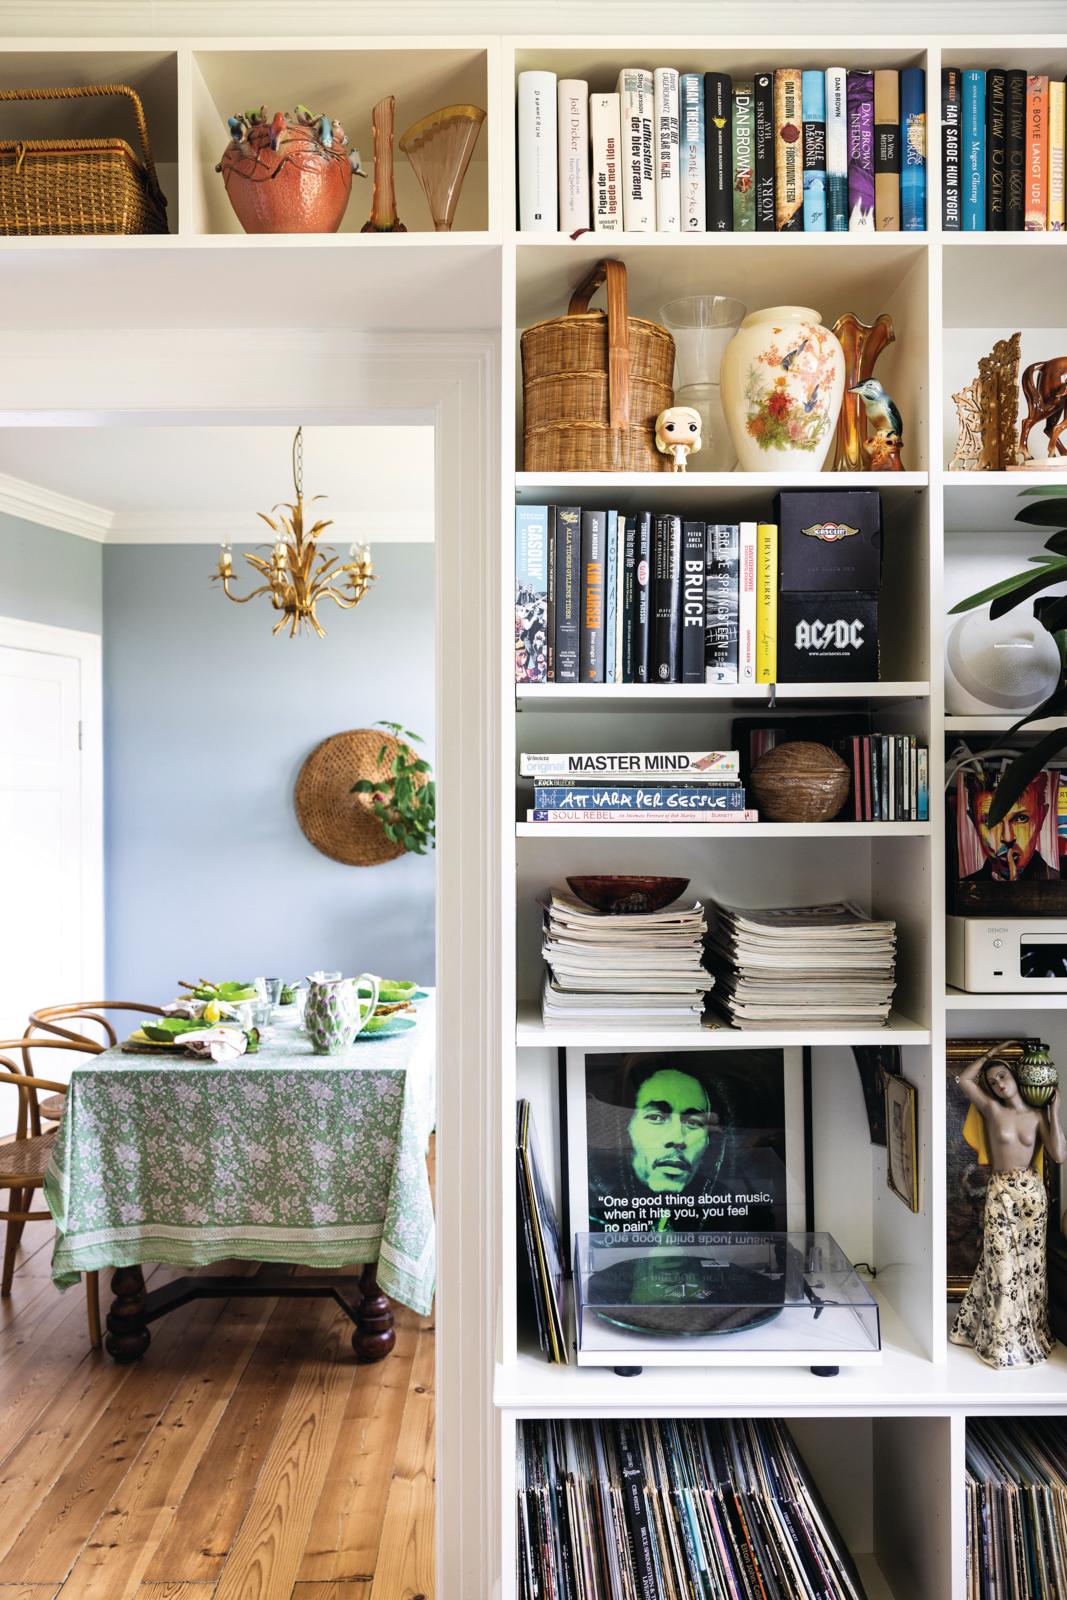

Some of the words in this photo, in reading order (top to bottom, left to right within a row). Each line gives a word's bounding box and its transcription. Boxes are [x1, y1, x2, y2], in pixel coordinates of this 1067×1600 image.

[686, 77, 699, 103] JOHAN
[785, 82, 795, 95] DAN
[735, 96, 750, 125] DAN
[785, 96, 796, 119] BROWN
[861, 103, 871, 127] DAN
[946, 105, 957, 125] HAN
[631, 117, 641, 132] der
[660, 117, 670, 131] IKKE
[670, 117, 678, 129] DET
[686, 106, 699, 142] THEORIN
[757, 101, 765, 159] SKYGGERNES
[764, 121, 772, 139] HAV
[1032, 109, 1041, 139] BOYLE
[570, 119, 580, 152] Dicker
[632, 136, 642, 157] blev
[805, 124, 815, 167] DÆMONER
[815, 130, 825, 160] ENGLE
[851, 113, 861, 159] INFERNO
[946, 128, 958, 162] SAGDE
[606, 137, 615, 161] ilden
[643, 117, 653, 181] Luftkastellet
[661, 151, 670, 160] OS
[688, 145, 698, 177] Sankt
[736, 131, 751, 178] BROWN
[861, 130, 871, 170] BROWN
[970, 141, 980, 170] Mogens
[1032, 143, 1041, 178] LANGT
[598, 172, 606, 187] der
[606, 163, 615, 182] med
[631, 160, 643, 201] sprængt
[947, 166, 957, 186] HUN
[607, 185, 617, 214] legede
[687, 182, 699, 213] Psyko
[762, 177, 774, 222] MØRK
[786, 187, 796, 203] TEGN
[970, 172, 981, 203] Glistrup
[1032, 183, 1041, 204] UDE
[598, 190, 607, 215] Pigen
[627, 529, 636, 541] This
[626, 548, 634, 557] my
[717, 530, 730, 569] BRUCE
[586, 563, 602, 585] KIM
[626, 558, 635, 568] life
[684, 560, 703, 627] BRUCE
[586, 587, 601, 629] LARSEN
[717, 573, 730, 649] SPRINGSTEEN
[527, 761, 565, 773] original
[568, 756, 641, 771] MASTER
[644, 755, 690, 769] MIND
[636, 789, 664, 808] PER
[666, 793, 727, 808] GESSLE
[552, 811, 581, 820] SOUL
[584, 811, 615, 820] REBEL
[631, 1194, 662, 1208] good
[665, 1194, 695, 1207] thing
[698, 1192, 732, 1204] about
[735, 1191, 774, 1203] music,
[604, 1208, 636, 1219] when
[639, 1207, 647, 1219] it
[650, 1207, 671, 1218] hits
[674, 1208, 699, 1220] you,
[703, 1207, 724, 1220] you
[727, 1205, 749, 1216] feel
[604, 1223, 620, 1232] no
[740, 1543, 750, 1559] Elton
